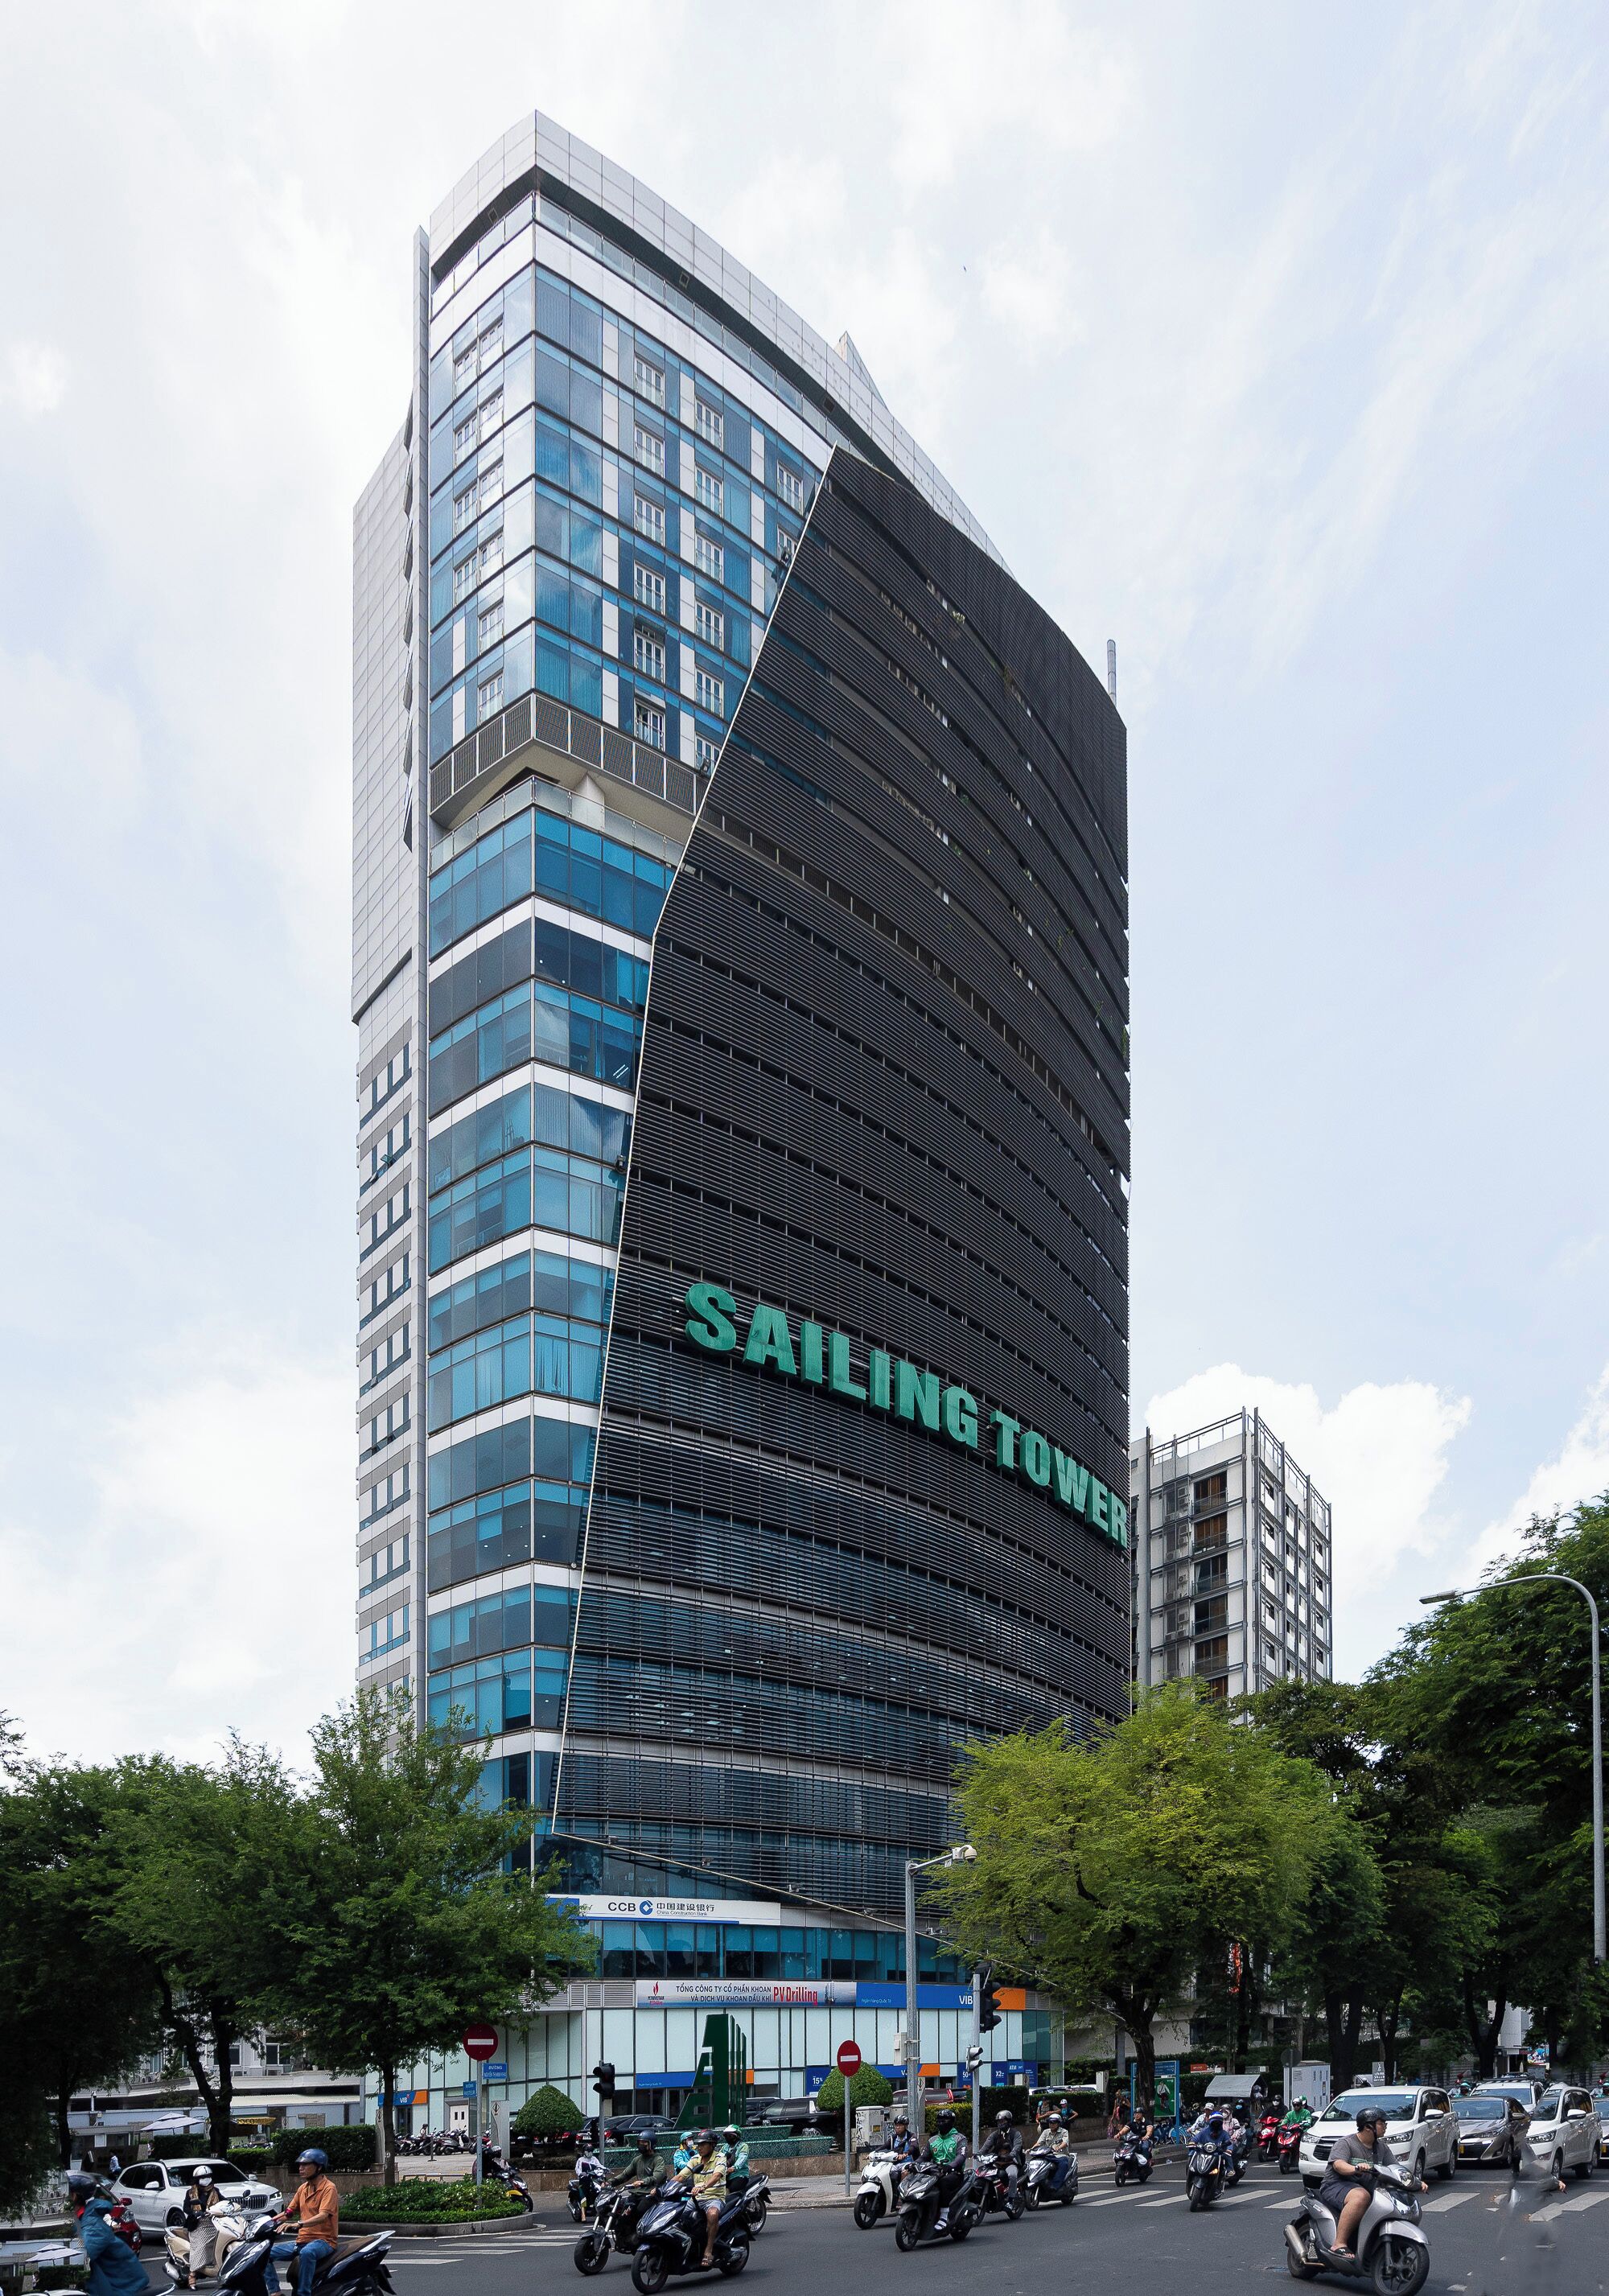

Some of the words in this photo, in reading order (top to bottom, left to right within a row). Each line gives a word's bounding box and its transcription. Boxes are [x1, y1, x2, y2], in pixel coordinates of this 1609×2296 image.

[685, 1282, 979, 1449] SAILING
[990, 1409, 1127, 1552] TOWER
[607, 1902, 636, 1912] CCB
[656, 1902, 715, 1912] 中国建设银行
[695, 1984, 713, 1993] CÔNG
[690, 1994, 700, 2002] VÀ
[958, 1994, 973, 2005] VIB
